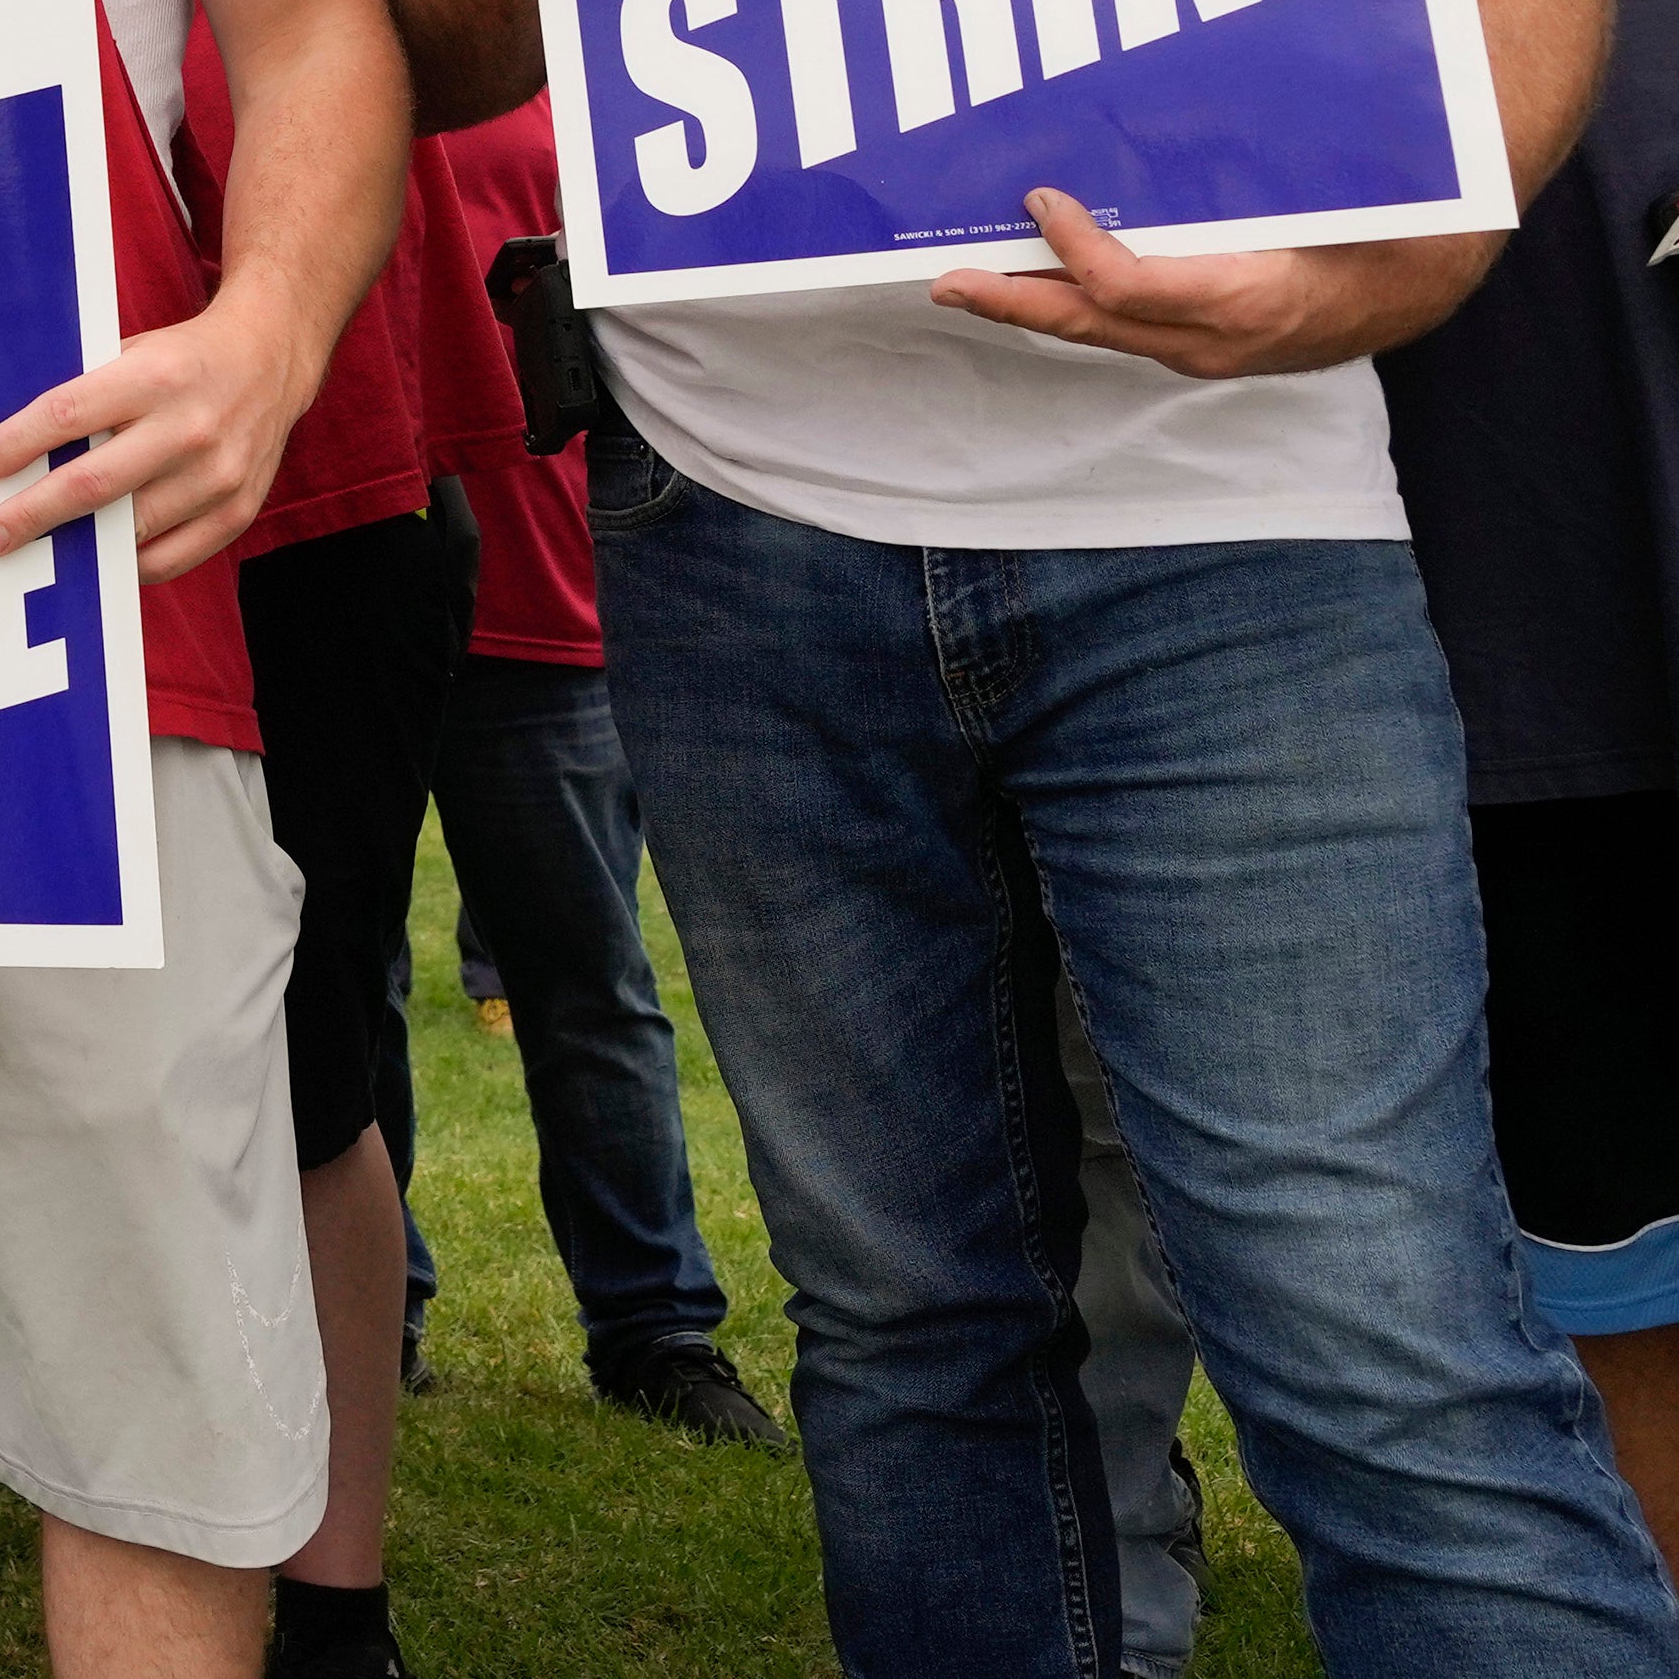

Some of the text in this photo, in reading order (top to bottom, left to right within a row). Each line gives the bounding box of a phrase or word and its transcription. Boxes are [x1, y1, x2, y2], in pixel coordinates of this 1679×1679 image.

[894, 231, 934, 242] SAWICKI
[945, 228, 965, 236] SON
[969, 225, 993, 234] (313)
[995, 221, 1036, 232] 962-2725
